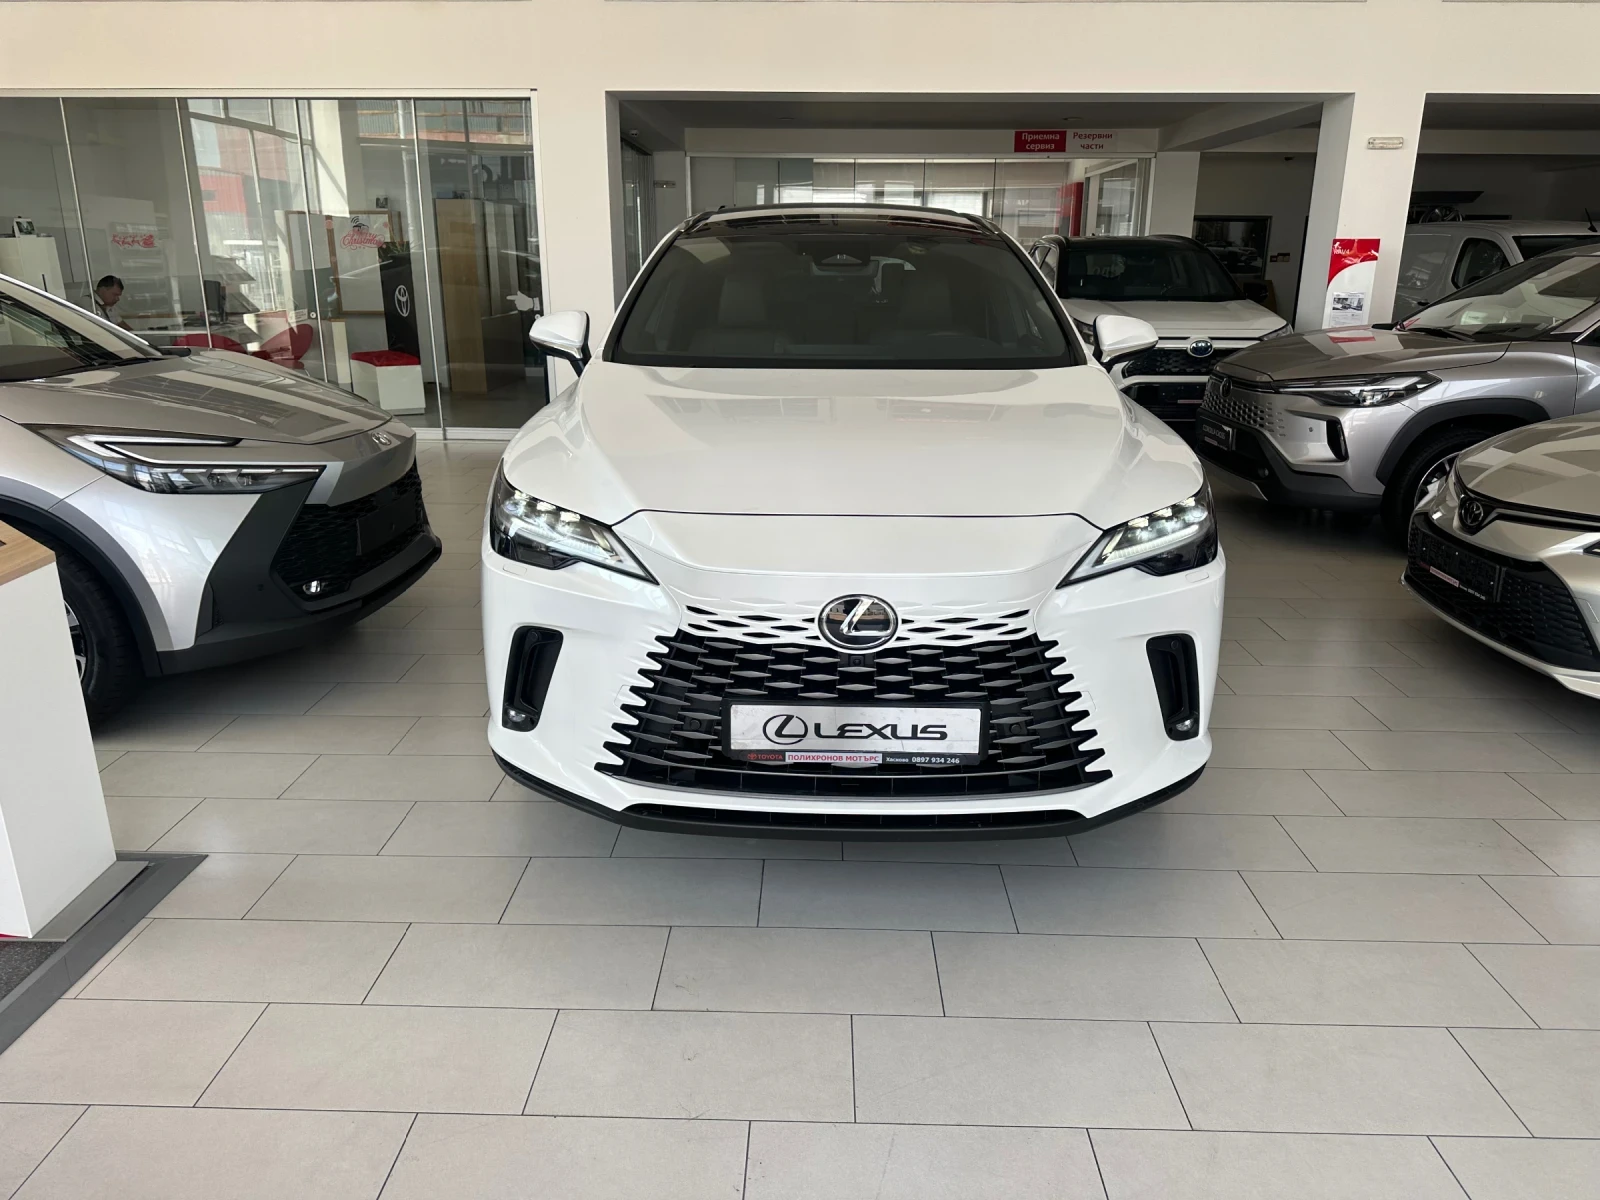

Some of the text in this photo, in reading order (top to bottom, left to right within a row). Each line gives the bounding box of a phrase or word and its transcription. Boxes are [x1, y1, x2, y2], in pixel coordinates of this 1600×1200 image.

[1021, 132, 1060, 142] Приемна
[1072, 132, 1113, 141] Резервни
[1025, 142, 1055, 151] сервиз
[813, 722, 949, 741] LEXUS
[757, 753, 784, 761] TOYOTA
[787, 754, 845, 762] ПОЛИХРОНОВ
[845, 754, 880, 762] МОТЪРС
